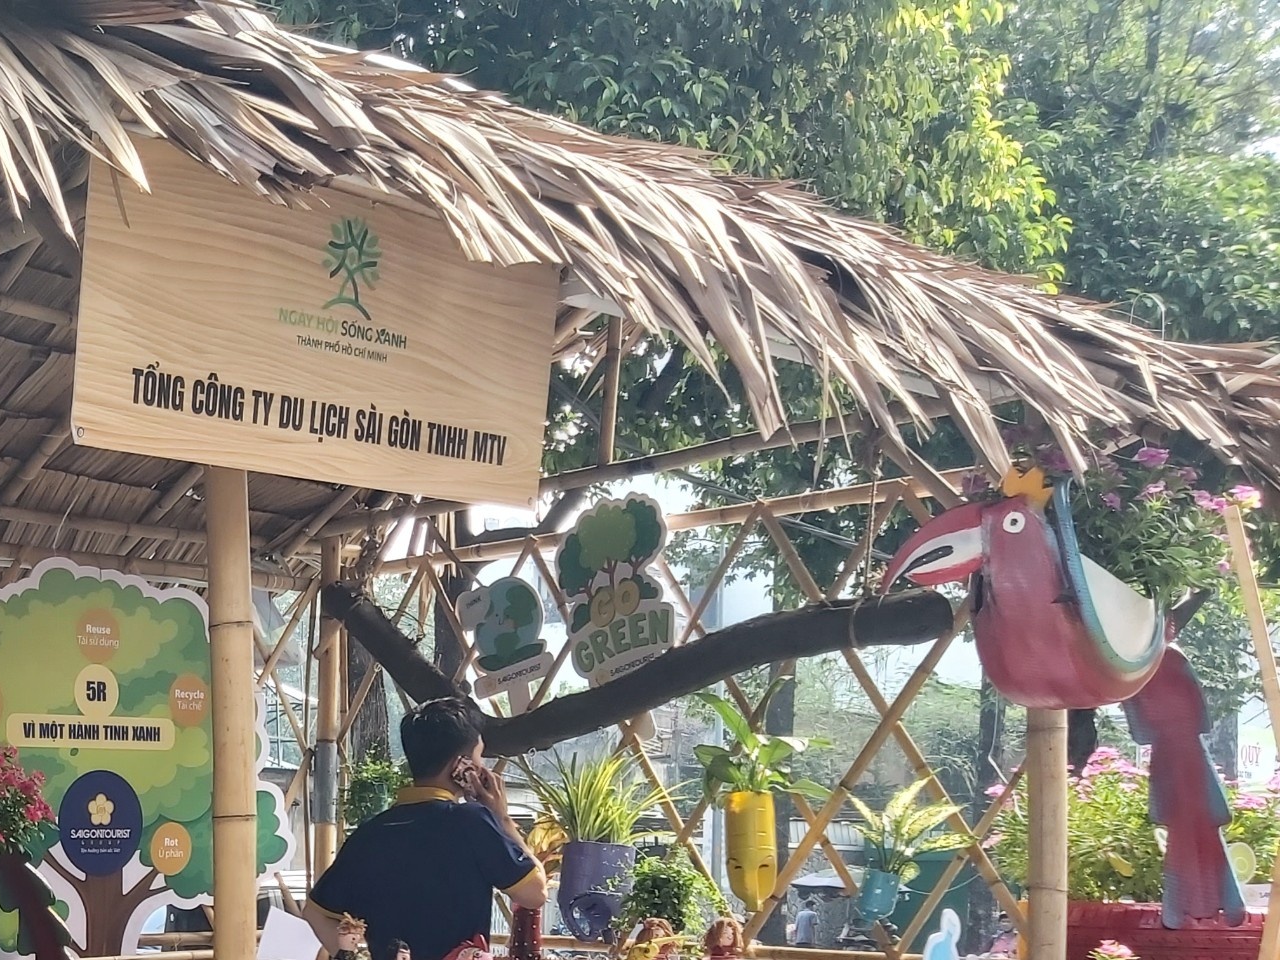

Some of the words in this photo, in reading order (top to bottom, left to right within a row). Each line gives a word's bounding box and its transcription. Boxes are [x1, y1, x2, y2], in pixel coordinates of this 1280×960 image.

[278, 307, 313, 328] NGÀY
[316, 316, 338, 335] HỘI
[340, 320, 373, 342] SỐNG
[374, 328, 407, 349] XANH
[296, 334, 322, 350] THÀNH
[324, 340, 340, 353] PHỐ
[341, 342, 353, 356] HỒ
[353, 346, 366, 357] CHÍ
[367, 349, 387, 363] MINH
[132, 361, 185, 411] TỔNG
[191, 372, 245, 421] CÔNG
[252, 389, 274, 426] TY
[278, 394, 304, 431] DU
[309, 400, 350, 443] LỊCH
[354, 402, 383, 445] SÀI
[387, 409, 422, 452] GÒN
[427, 421, 468, 460] TNHH
[471, 430, 507, 466] MTV
[589, 578, 640, 628] GO
[86, 624, 111, 635] Reuse
[574, 608, 670, 673] GREEN
[86, 681, 107, 702] 5R
[175, 689, 205, 702] Recycle
[23, 719, 36, 739] VÌ
[39, 722, 66, 743] MỘT
[69, 721, 100, 741] HÀNH
[103, 724, 129, 741] TINH
[132, 725, 161, 742] XANH
[70, 829, 131, 839] SAIGONTOURIST
[164, 837, 179, 847] Rot
